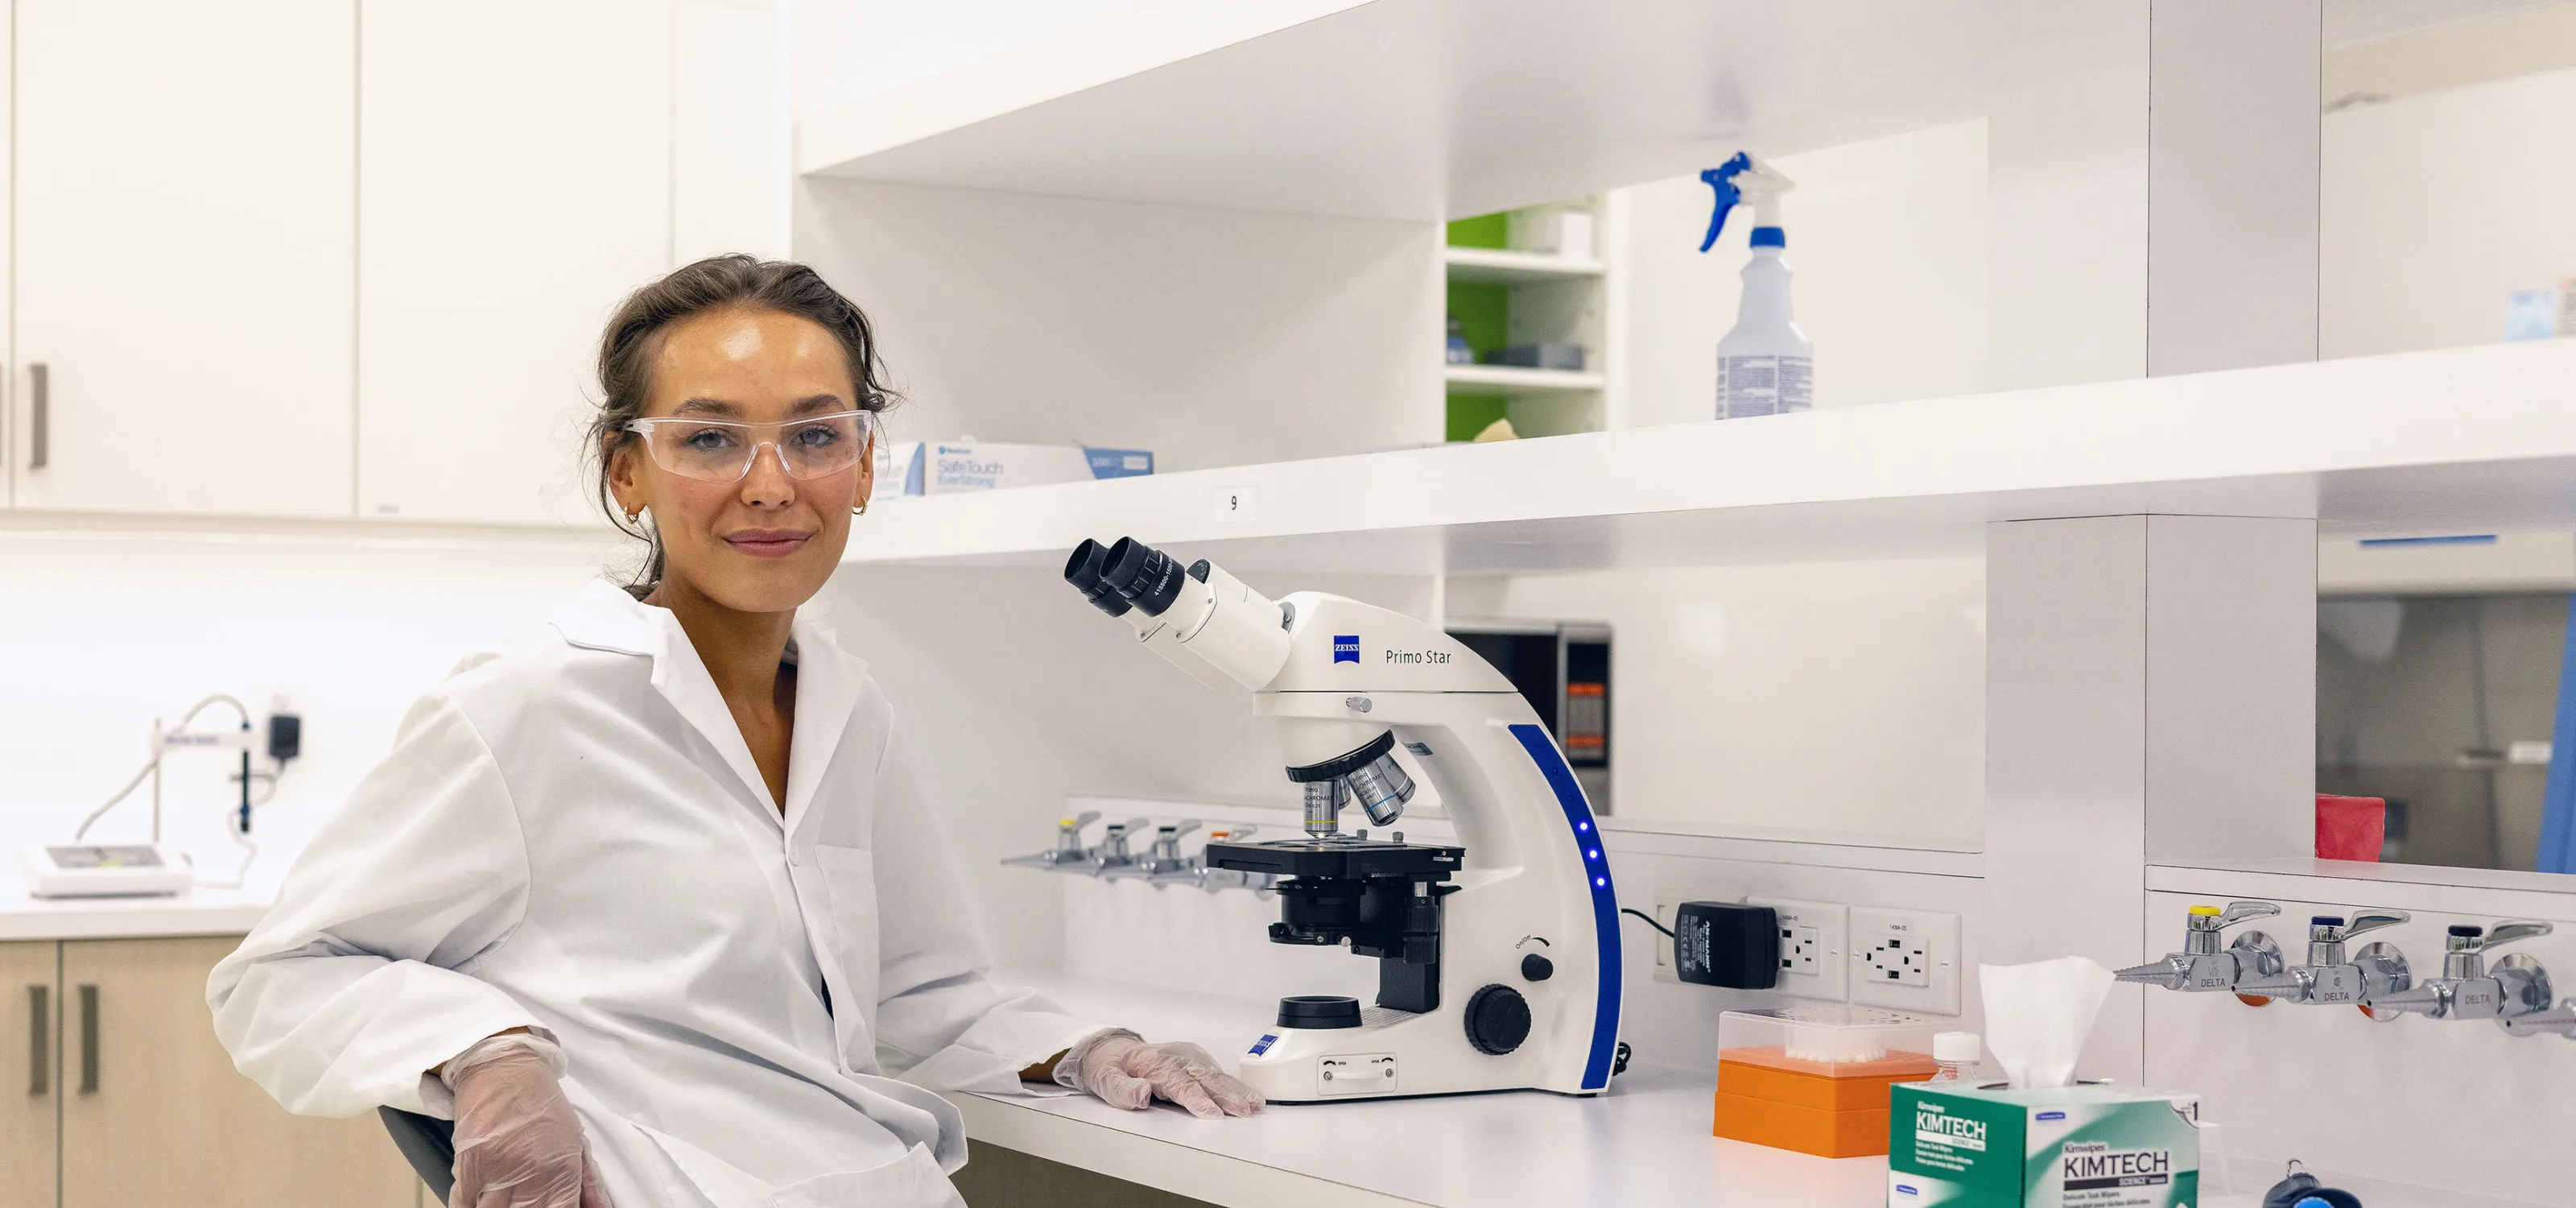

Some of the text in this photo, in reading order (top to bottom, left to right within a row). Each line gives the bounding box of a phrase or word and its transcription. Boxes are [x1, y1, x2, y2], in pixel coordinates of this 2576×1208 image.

[1231, 495, 1237, 511] 9
[1335, 643, 1359, 652] ZEISS
[1386, 650, 1451, 664] Primo Star
[1515, 934, 1531, 949] On/Off
[2201, 978, 2226, 987] DELTA
[2324, 992, 2350, 1001] DELTA
[2465, 994, 2491, 1005] DELTA
[1916, 1111, 1987, 1140] KIMTECH
[2064, 1143, 2106, 1155] Kimwipes
[2064, 1151, 2169, 1178] KIMTECH
